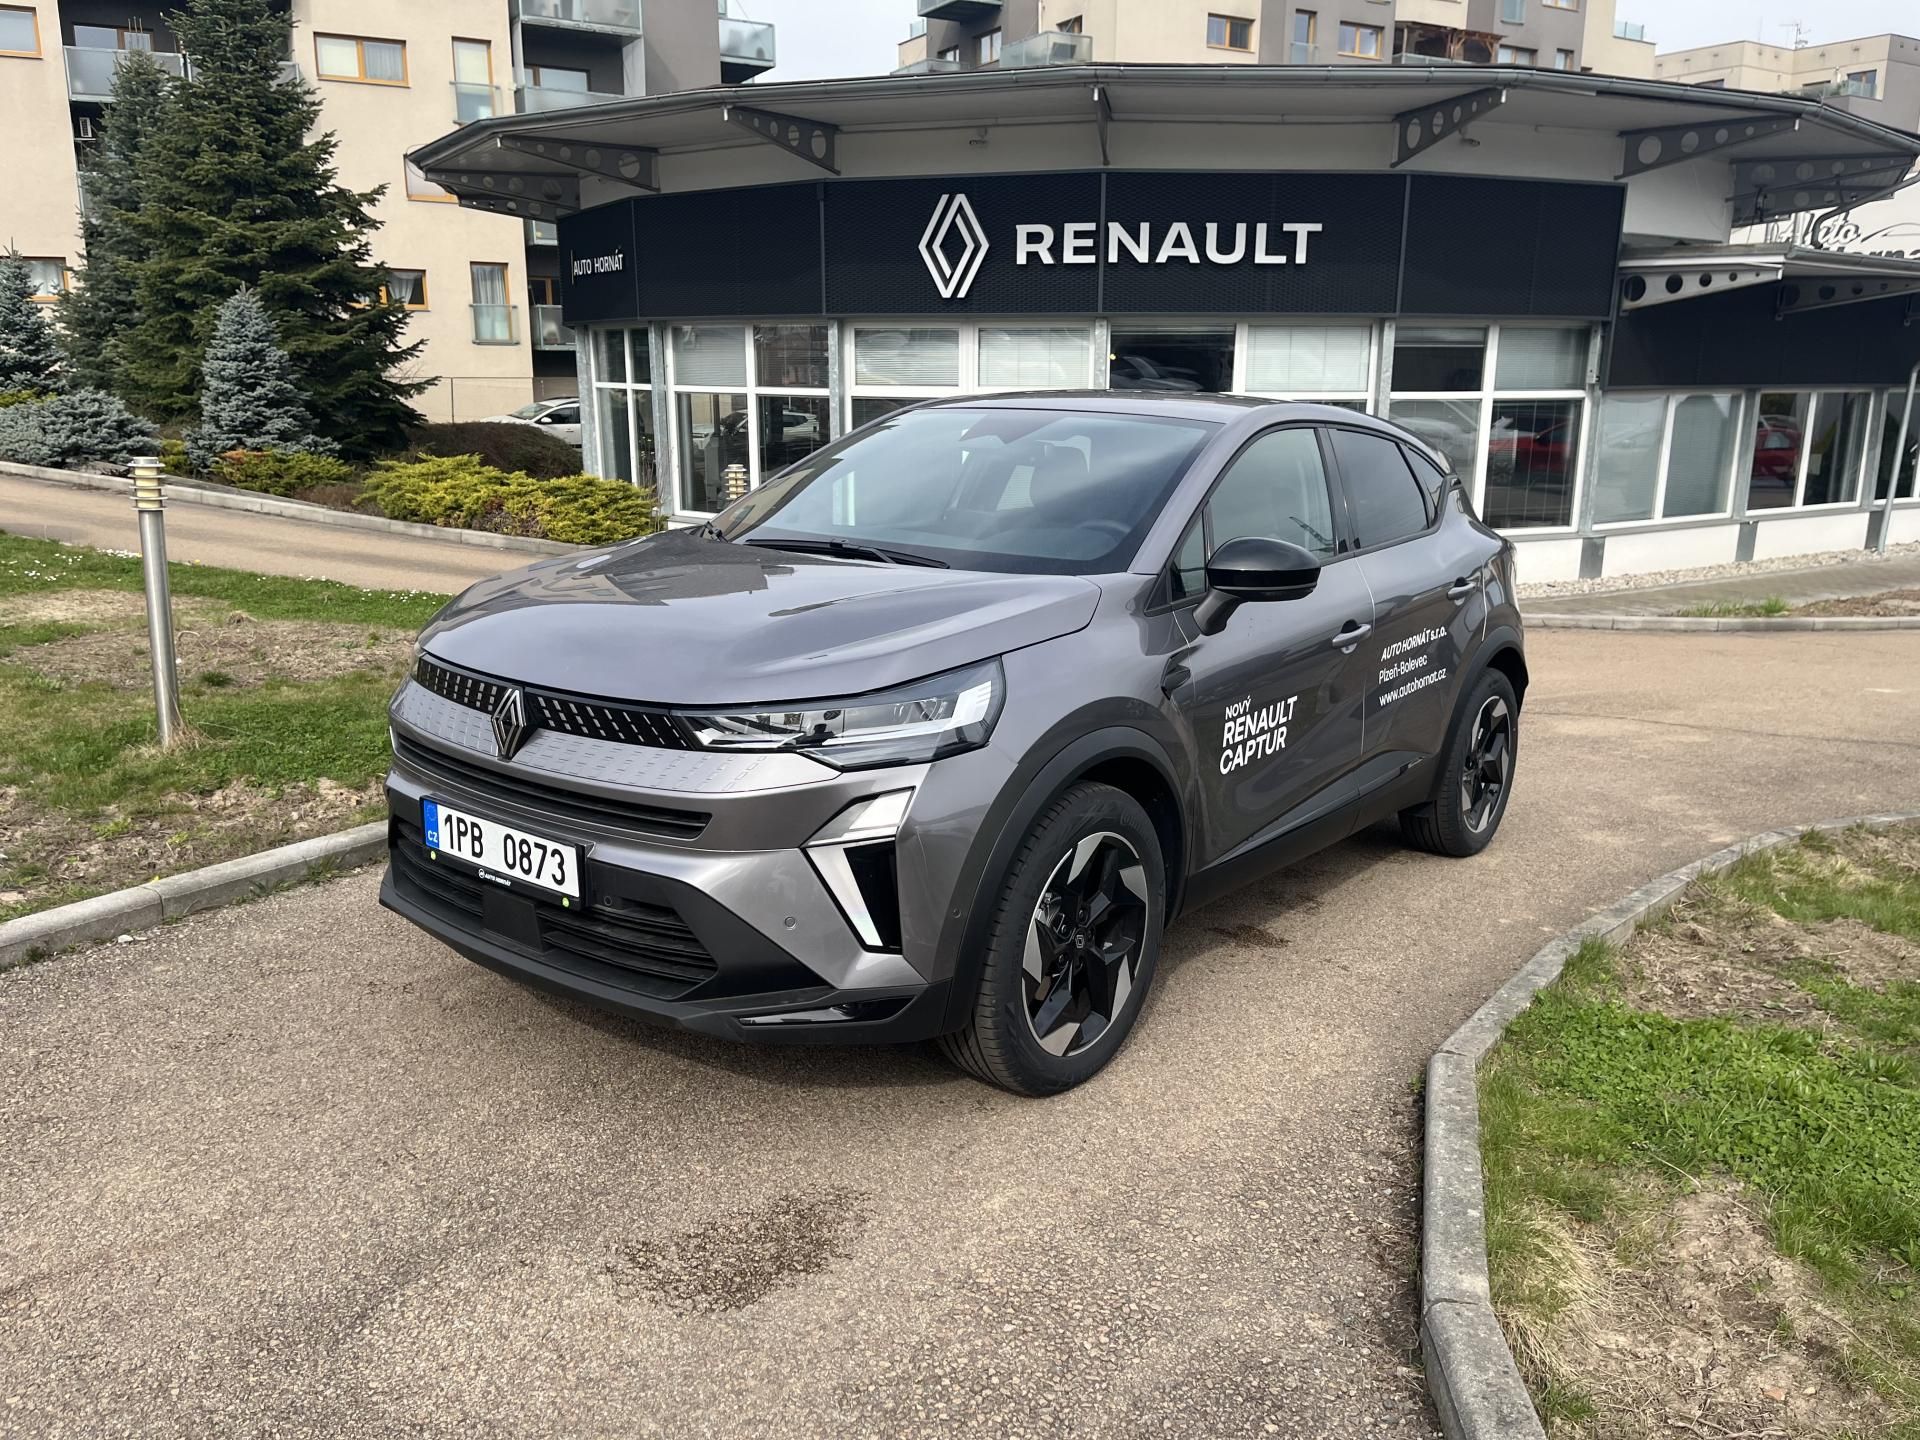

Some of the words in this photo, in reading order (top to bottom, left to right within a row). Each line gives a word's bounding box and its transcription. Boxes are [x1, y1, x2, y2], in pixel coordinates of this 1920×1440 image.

[1015, 222, 1323, 265] RENAULT
[573, 259, 592, 276] AUTO
[594, 249, 624, 273] HORNÁT
[1381, 641, 1402, 662] AUTO
[1402, 628, 1431, 653] HORNÁT
[1379, 654, 1428, 685] Plzeň-Bolevec
[1379, 668, 1447, 707] www.autohornat.cz
[1222, 695, 1298, 748] RENAULT
[1225, 695, 1251, 720] NOVÝ
[1220, 726, 1287, 775] CAPTUR
[427, 830, 438, 843] CZ
[444, 813, 484, 859] 1PB
[503, 833, 566, 886] 0873
